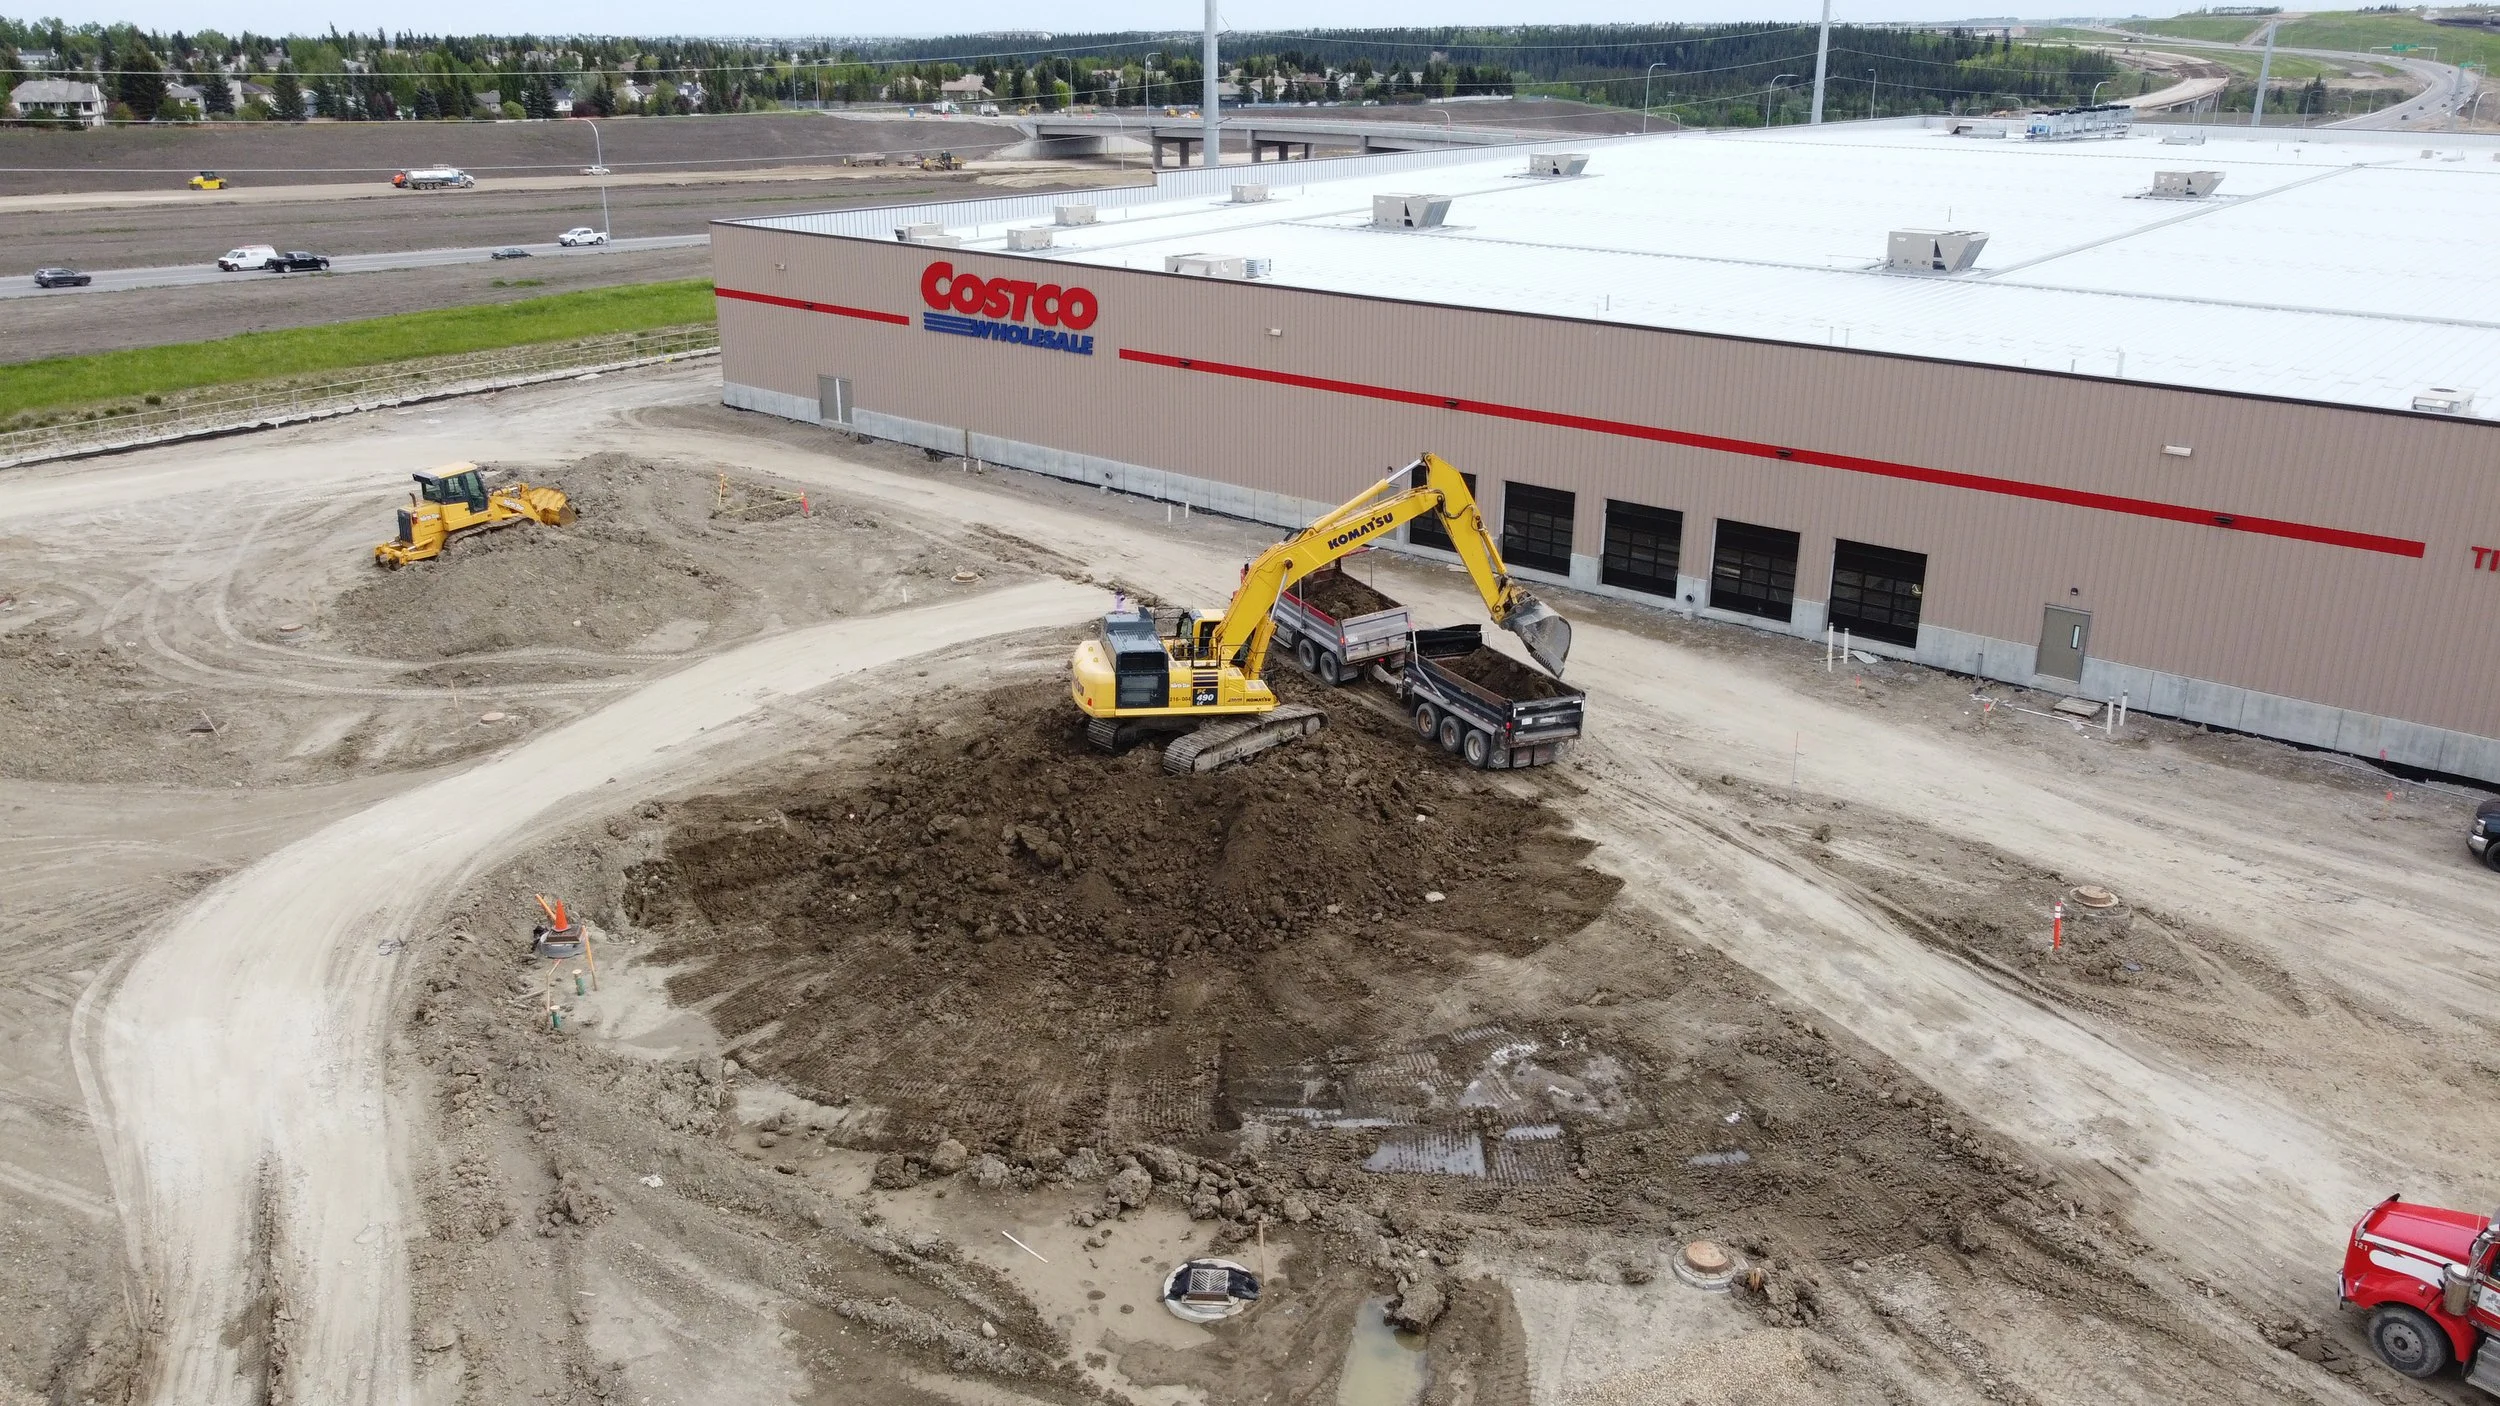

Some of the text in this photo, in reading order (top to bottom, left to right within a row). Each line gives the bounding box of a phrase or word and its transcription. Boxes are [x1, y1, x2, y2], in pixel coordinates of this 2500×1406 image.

[921, 261, 1098, 330] COSTCO
[972, 319, 1094, 355] WHOLESALE
[1327, 512, 1394, 550] KOMATSU
[2354, 1240, 2368, 1251] 121
